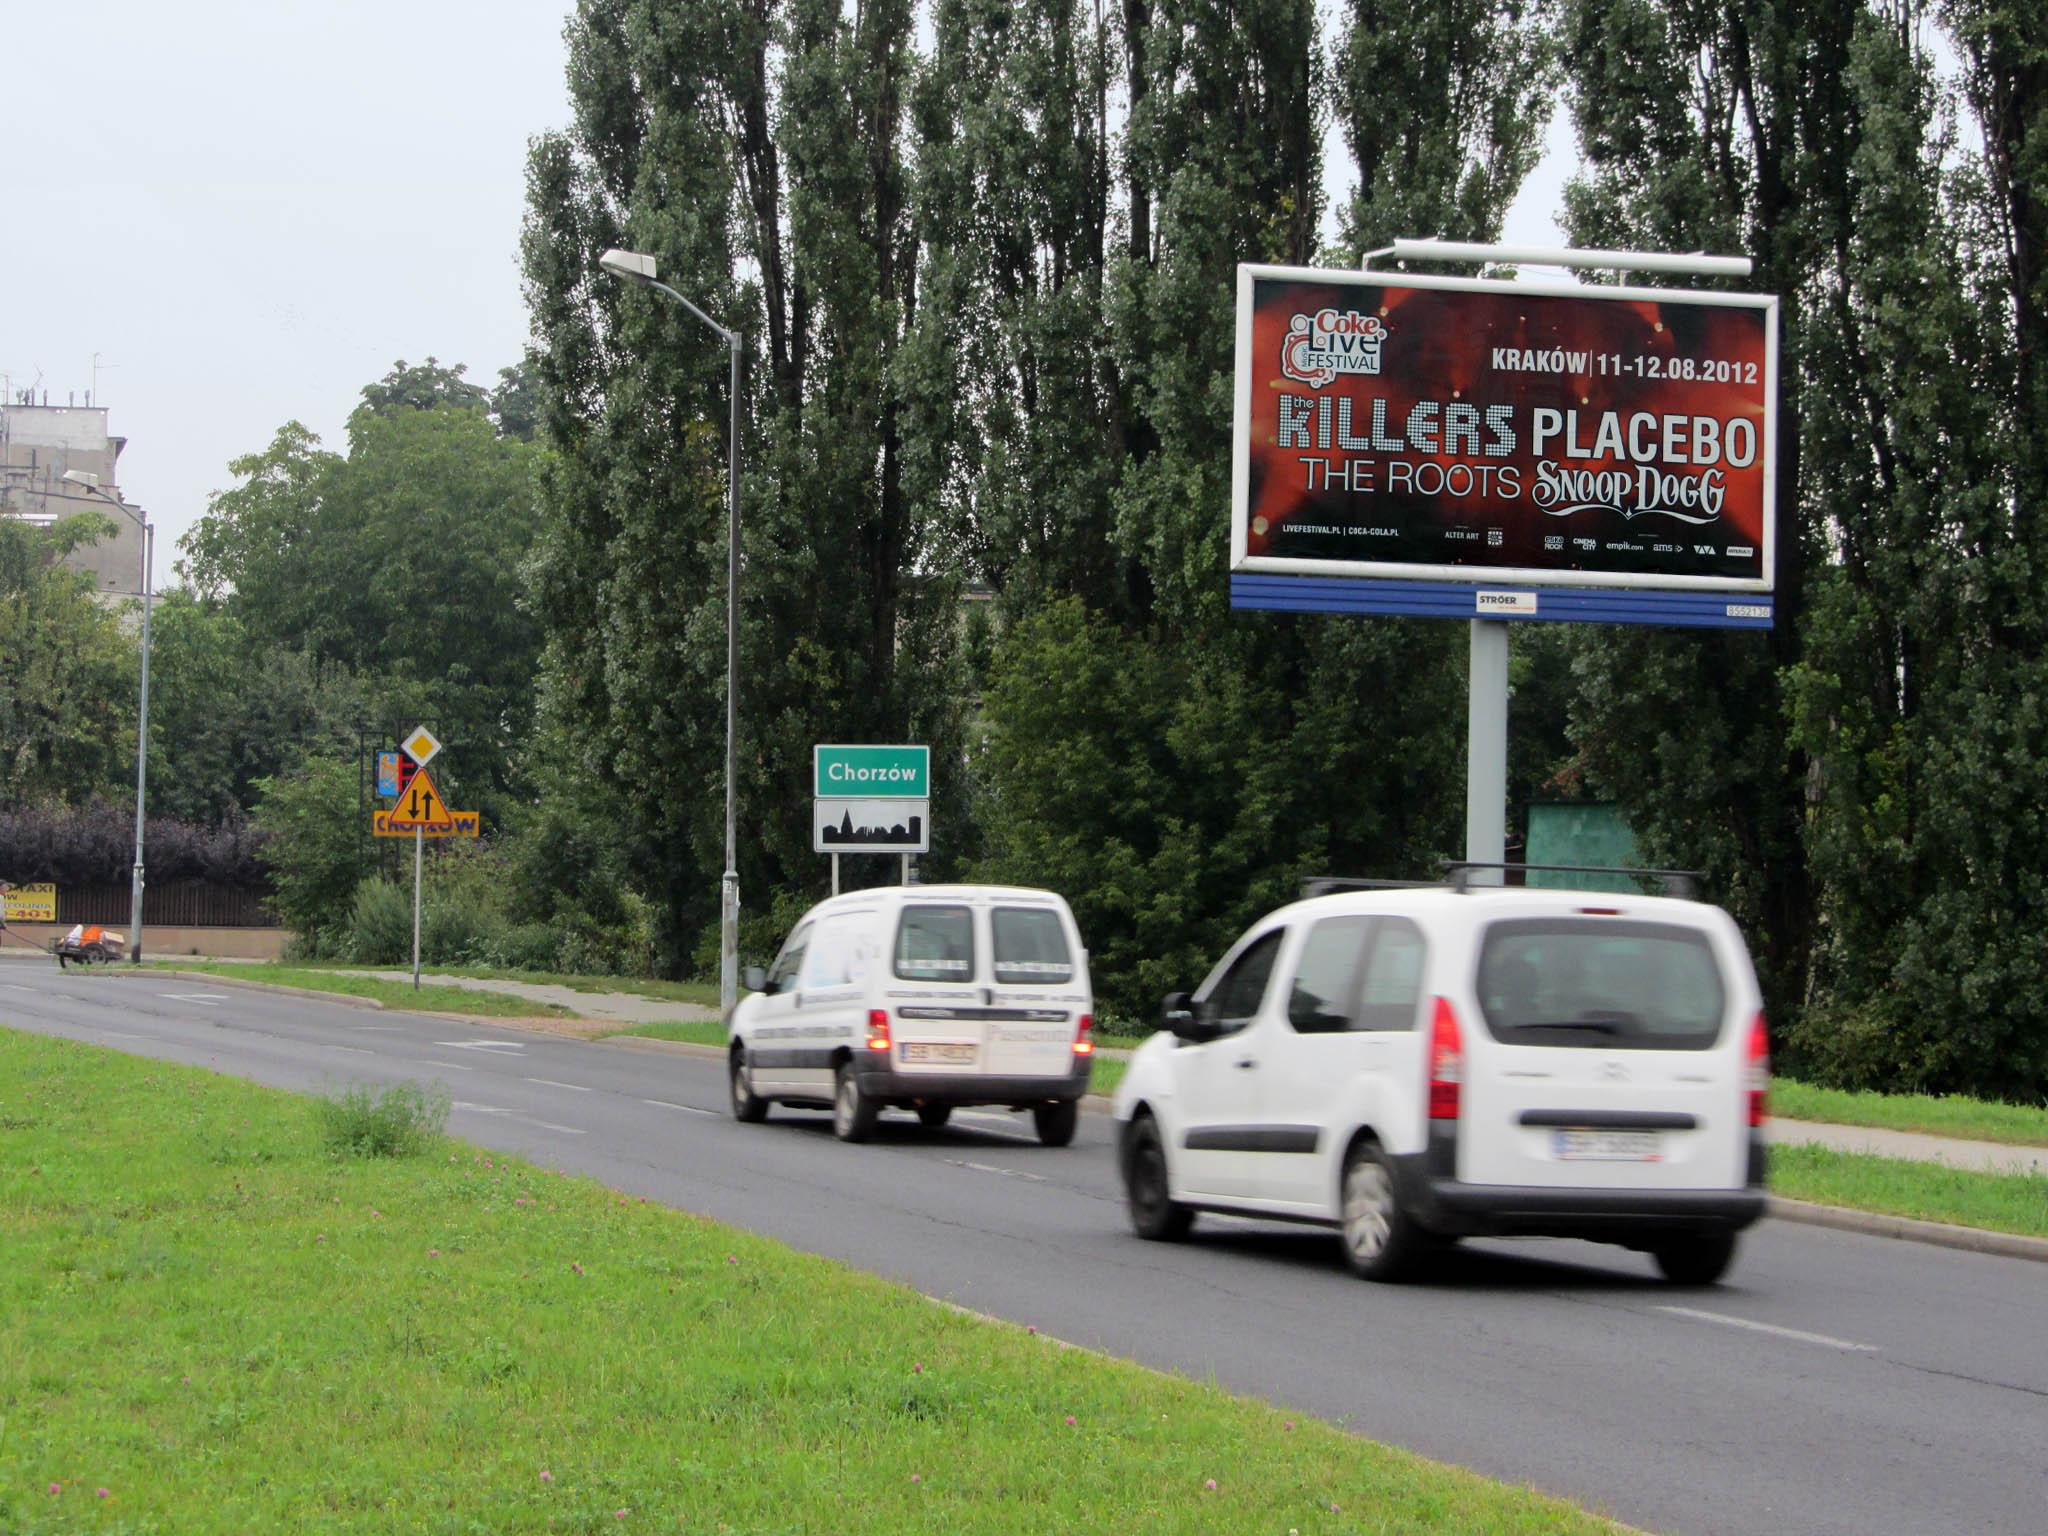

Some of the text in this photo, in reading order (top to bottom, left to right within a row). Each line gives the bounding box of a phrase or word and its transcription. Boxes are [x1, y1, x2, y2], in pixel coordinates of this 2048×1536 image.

[1316, 311, 1378, 335] Coke
[1308, 320, 1379, 355] Live
[1308, 353, 1378, 370] FESTIVAL
[1491, 345, 1758, 385] KRAKÓW 11-12.08.2012
[1293, 396, 1314, 408] the
[1278, 394, 1516, 457] KILLERS
[1532, 406, 1758, 468] PLACEBO
[1298, 457, 1522, 500] THE ROOTS
[1282, 524, 1400, 537] LIVEFESTIVAL.PL COCA-COLA.PL
[1444, 531, 1465, 540] ALTER
[1466, 532, 1480, 541] ART
[1583, 543, 1597, 551] CITY
[1653, 543, 1674, 553] ams
[1479, 594, 1517, 605] STRÖER
[827, 762, 917, 782] Chorzów
